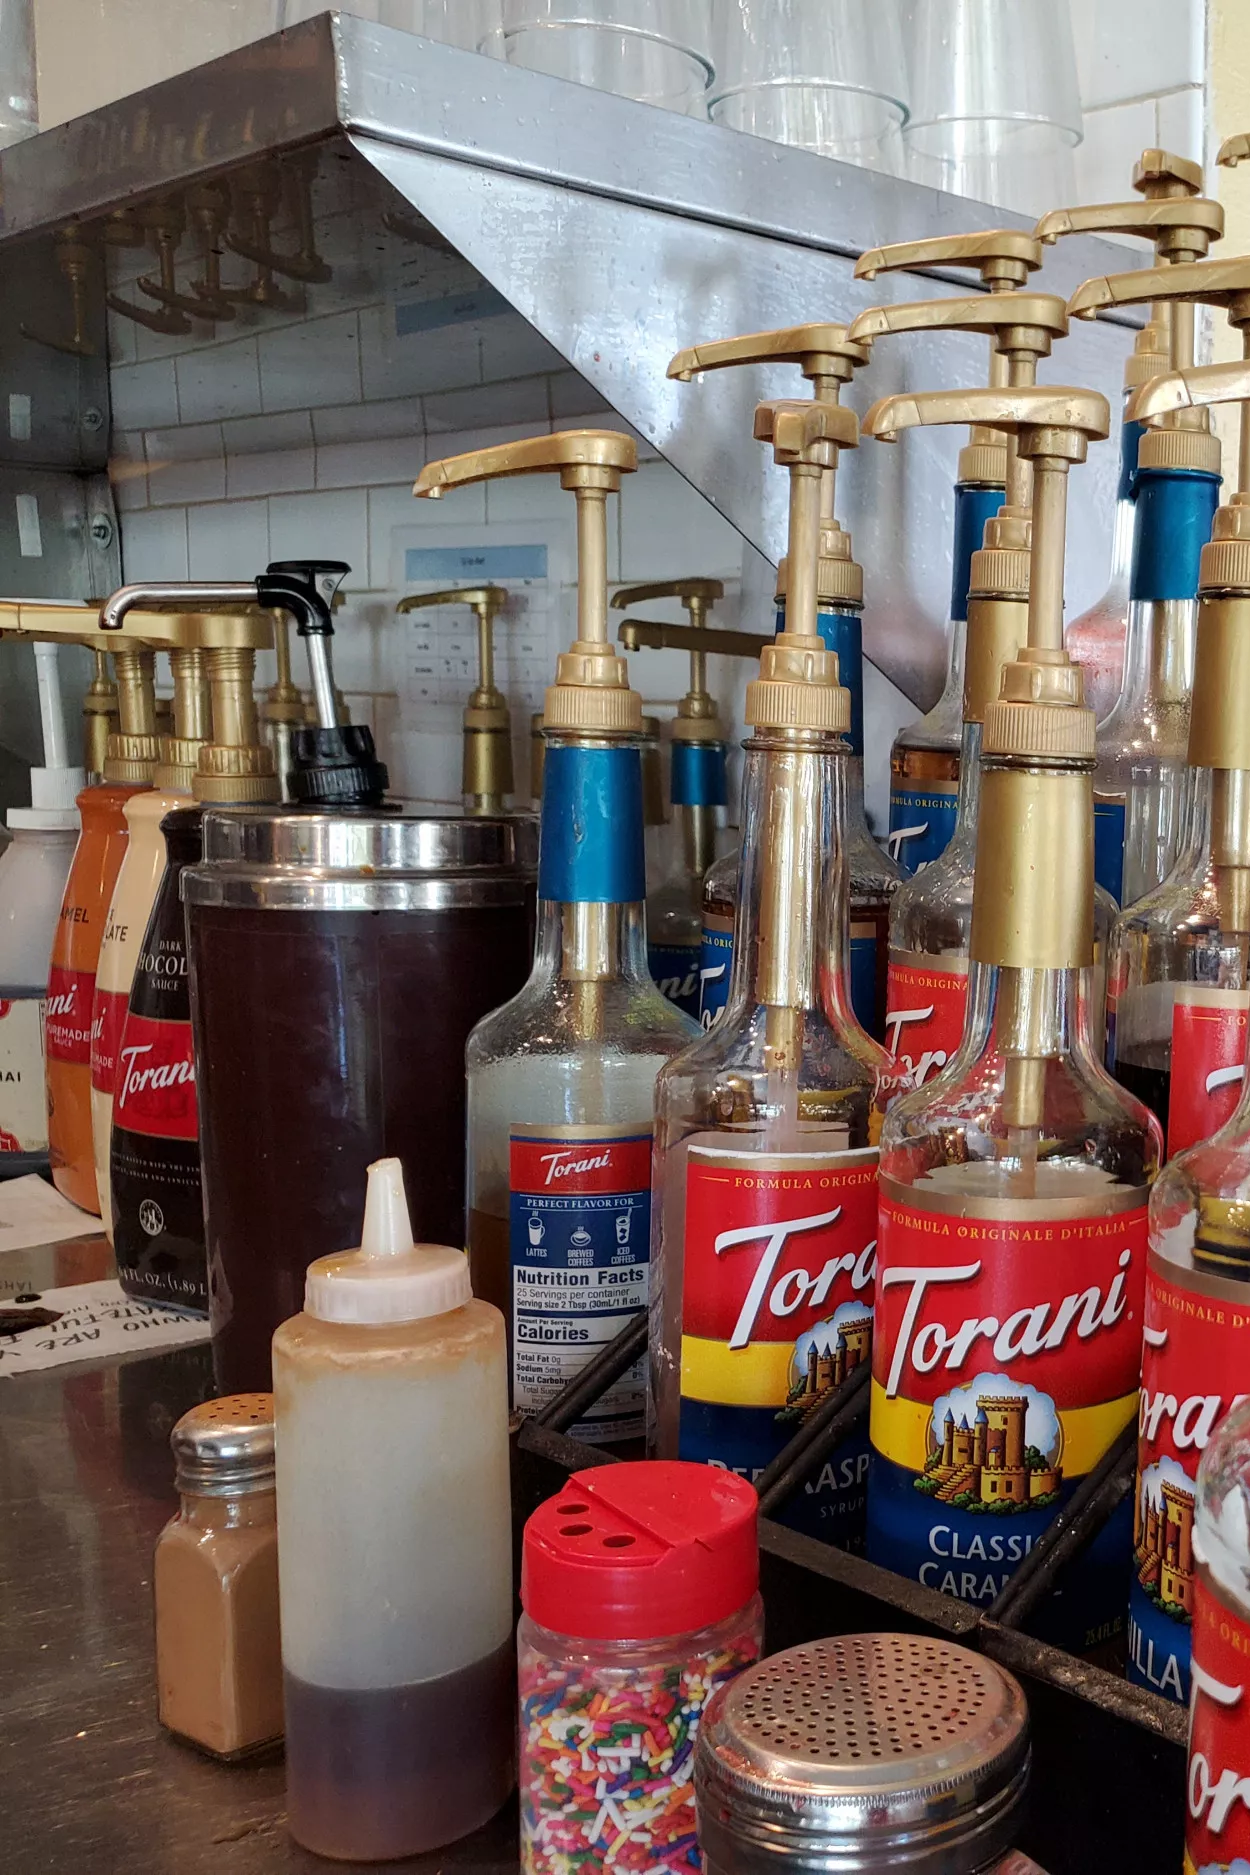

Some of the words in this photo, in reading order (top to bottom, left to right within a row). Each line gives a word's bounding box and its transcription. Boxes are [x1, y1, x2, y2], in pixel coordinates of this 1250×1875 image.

[159, 940, 181, 952] DARK
[151, 980, 179, 992] SAUCE
[120, 1044, 196, 1109] Torani
[540, 1149, 611, 1185] Torani
[734, 1176, 813, 1190] FORMULA
[527, 1198, 569, 1209] PERFECT
[571, 1199, 612, 1209] FLAVOR
[614, 1198, 634, 1207] FOR
[892, 1211, 950, 1236] FORMULA
[956, 1226, 1054, 1242] ORIGINALE
[1061, 1221, 1126, 1240] D'ITALIA
[526, 1247, 547, 1257] LATTES
[567, 1249, 594, 1258] BREWED
[616, 1246, 630, 1256] ICED
[567, 1258, 594, 1267] COFFEES
[611, 1254, 636, 1265] COFFEES
[516, 1269, 590, 1286] Nutrition
[598, 1268, 645, 1285] Facts
[516, 1287, 527, 1297] 25
[529, 1288, 567, 1300] Servings
[570, 1290, 585, 1300] per
[587, 1288, 630, 1299] container
[516, 1298, 543, 1309] Serving
[568, 1300, 587, 1309] Tbsp
[882, 1248, 1131, 1399] Torani
[517, 1324, 589, 1340] Calories
[516, 1353, 535, 1362] Total
[536, 1354, 550, 1363] Fat
[516, 1363, 543, 1373] Sodium
[516, 1374, 535, 1383] Total
[523, 1385, 539, 1394] Total
[805, 1453, 869, 1494] ASP
[820, 1497, 864, 1518] SYRUP
[918, 1561, 1011, 1599] CARA
[1128, 1615, 1184, 1700] ILLA
